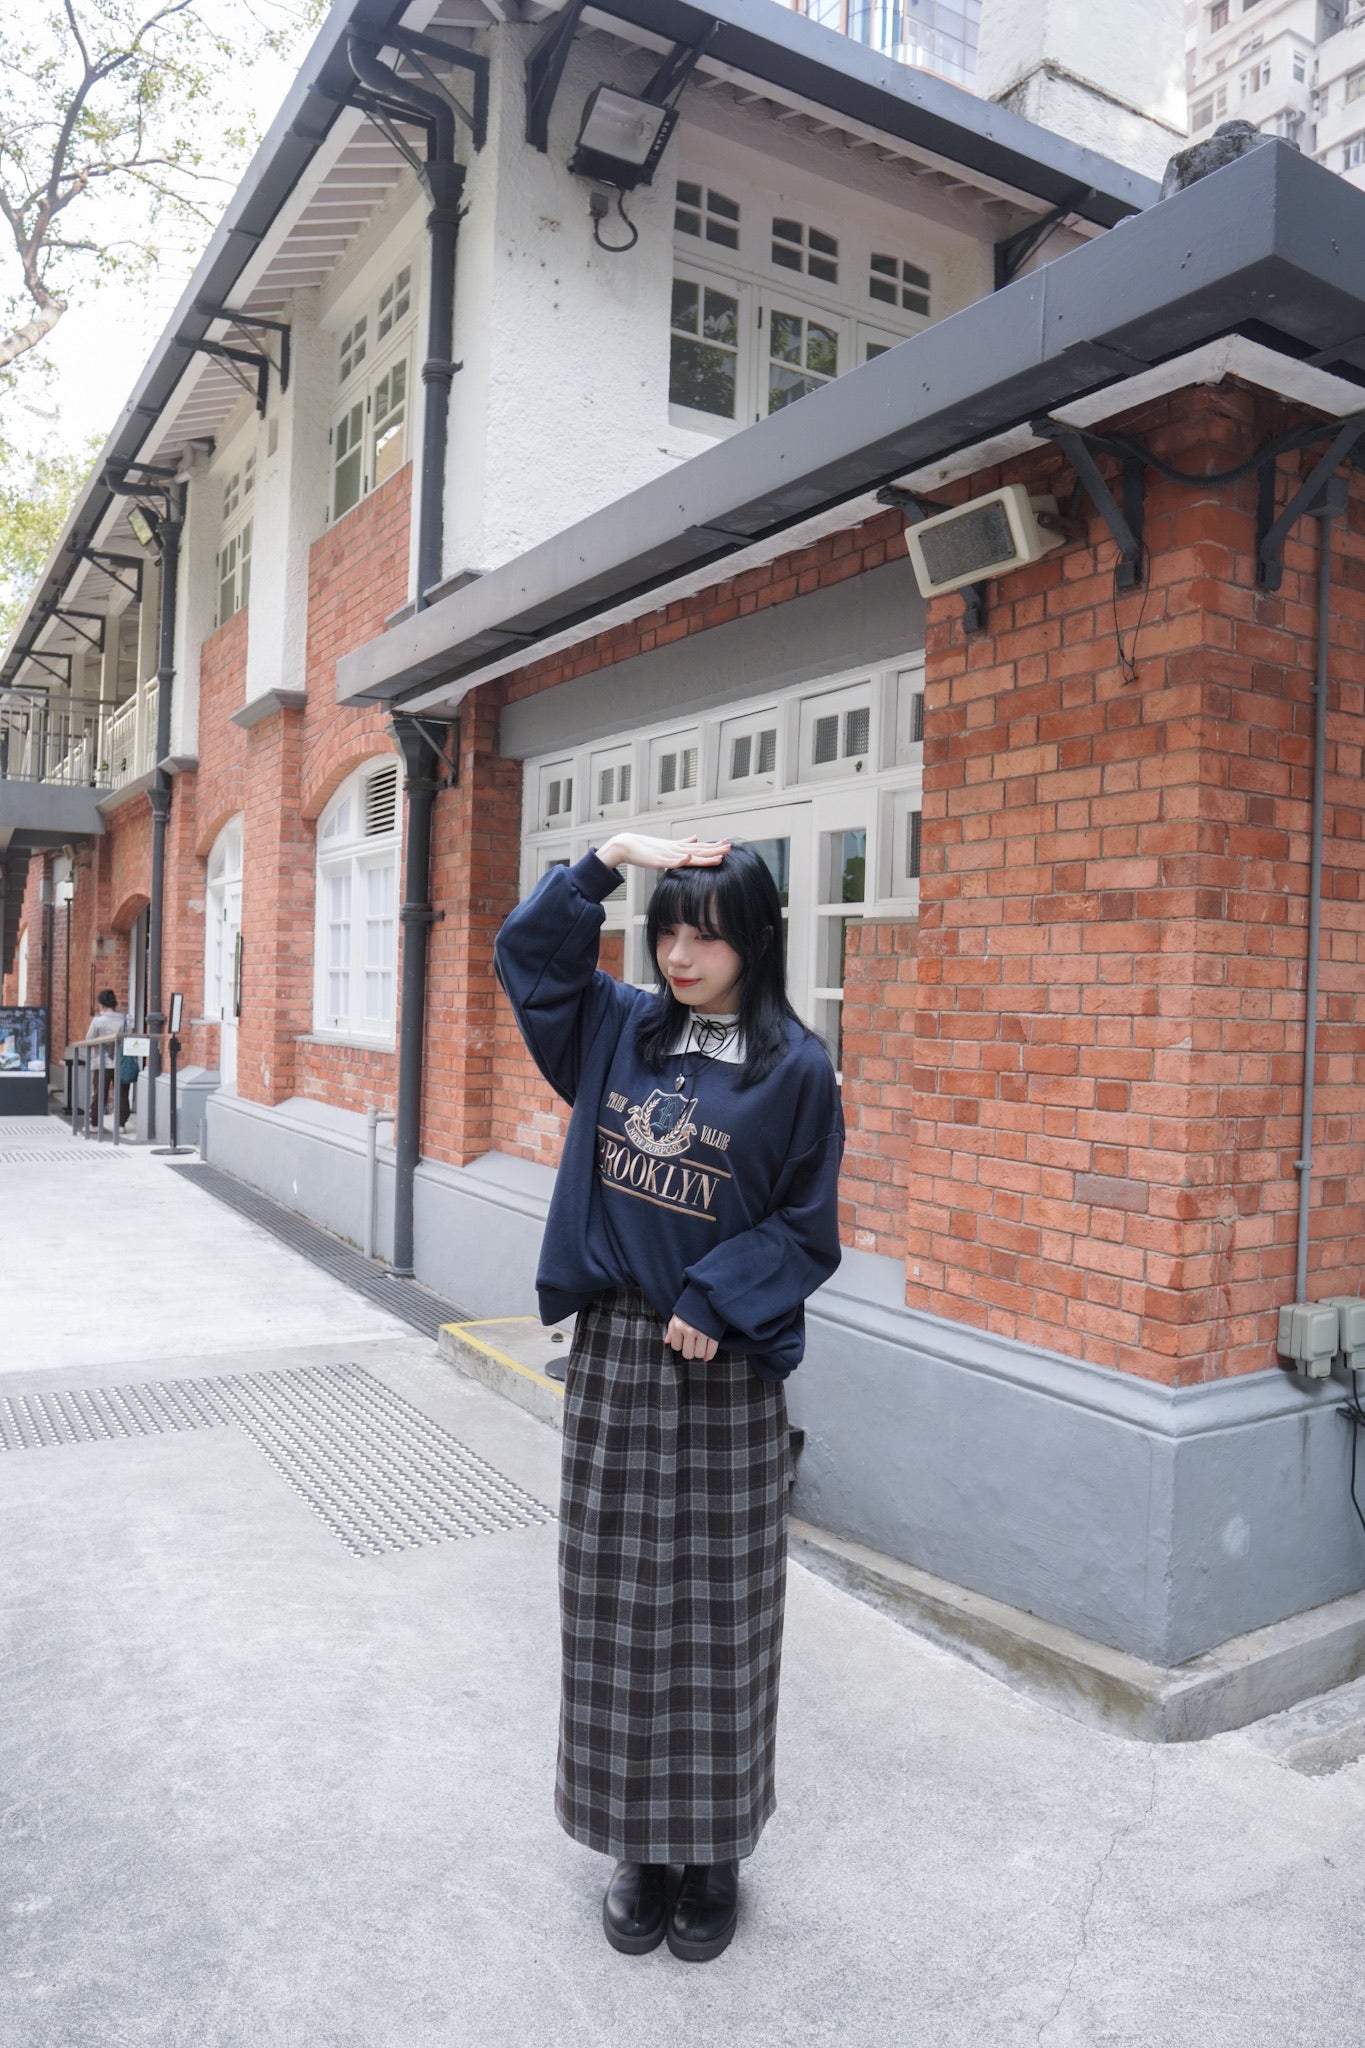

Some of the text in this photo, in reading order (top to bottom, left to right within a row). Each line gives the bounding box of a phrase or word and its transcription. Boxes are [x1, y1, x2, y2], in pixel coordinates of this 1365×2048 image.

[606, 1091, 731, 1151] TRUE VALUE
[628, 1127, 684, 1155] NEW PURPOSE
